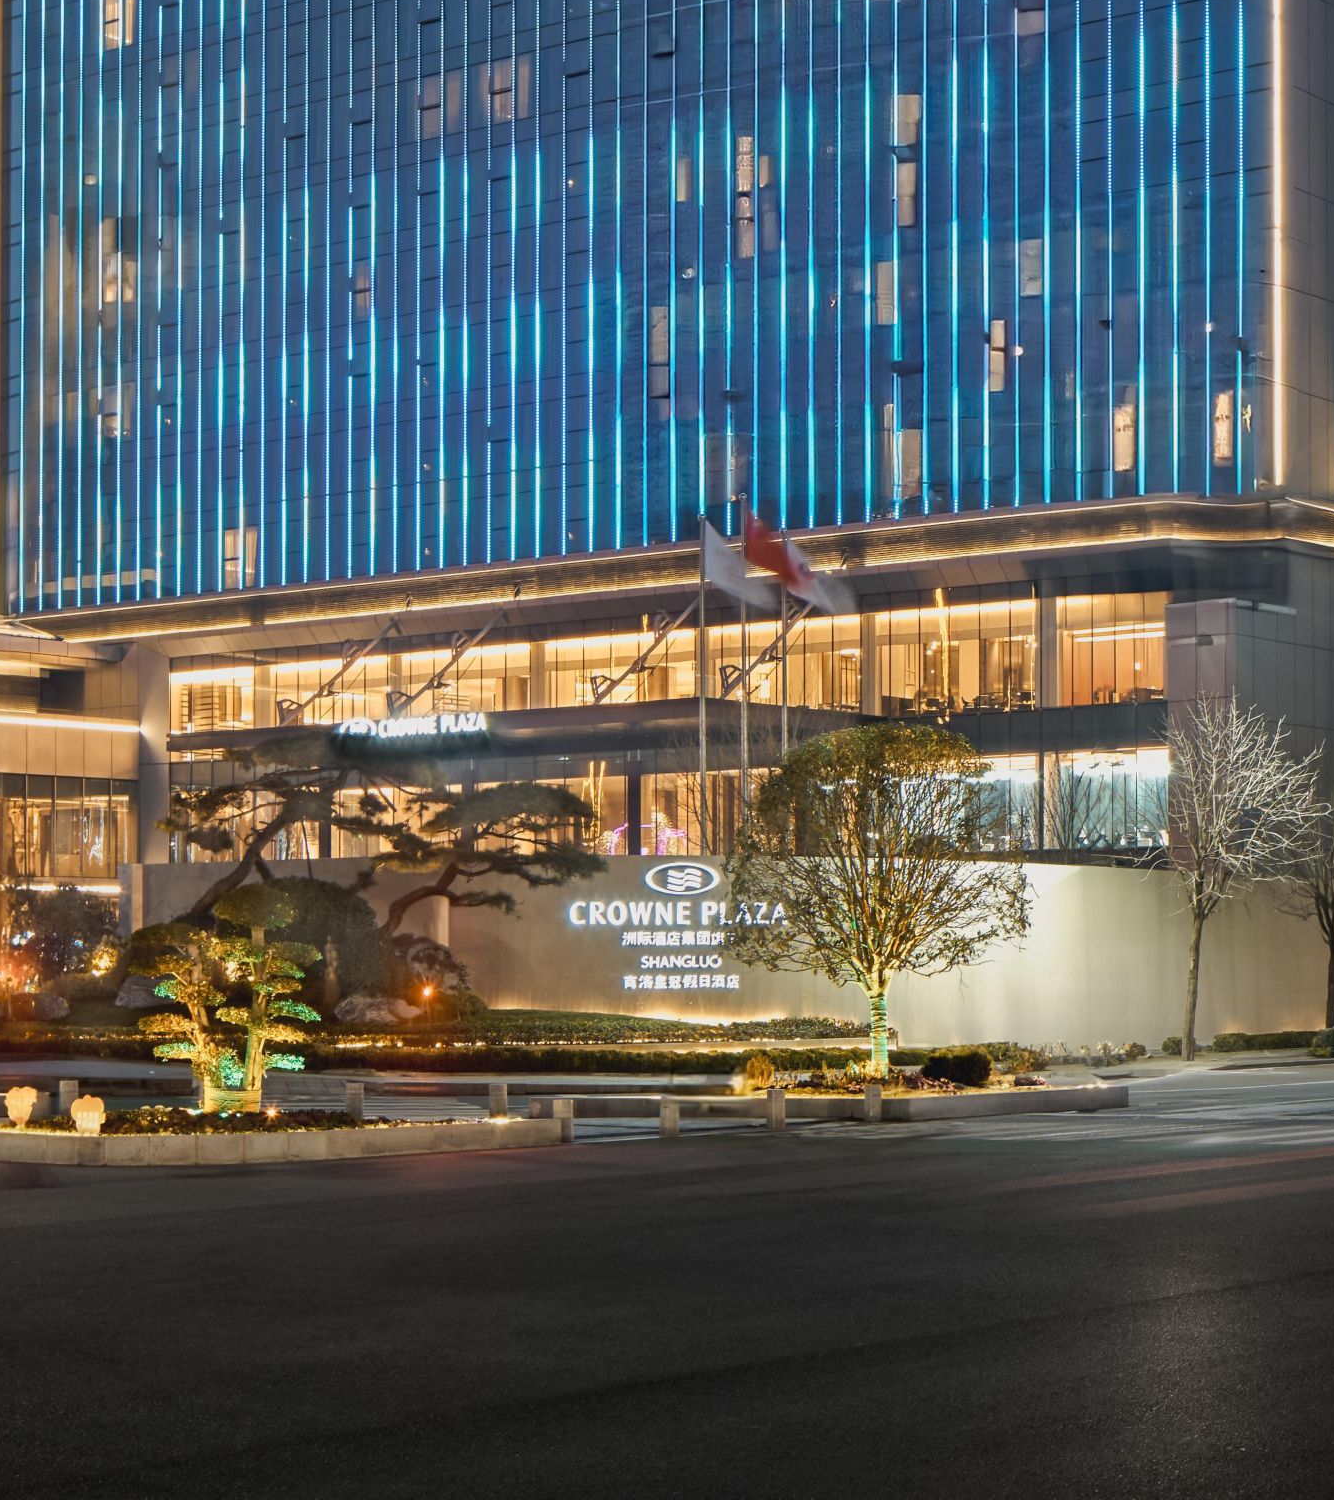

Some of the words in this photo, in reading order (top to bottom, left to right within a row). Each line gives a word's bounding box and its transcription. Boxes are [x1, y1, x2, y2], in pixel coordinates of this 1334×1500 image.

[440, 712, 487, 733] PLAZA
[569, 901, 691, 925] CROWNE
[701, 901, 788, 925] PLAZA
[640, 954, 722, 969] SHANGLUO
[623, 974, 740, 989] 商洛皇冠假日酒店
